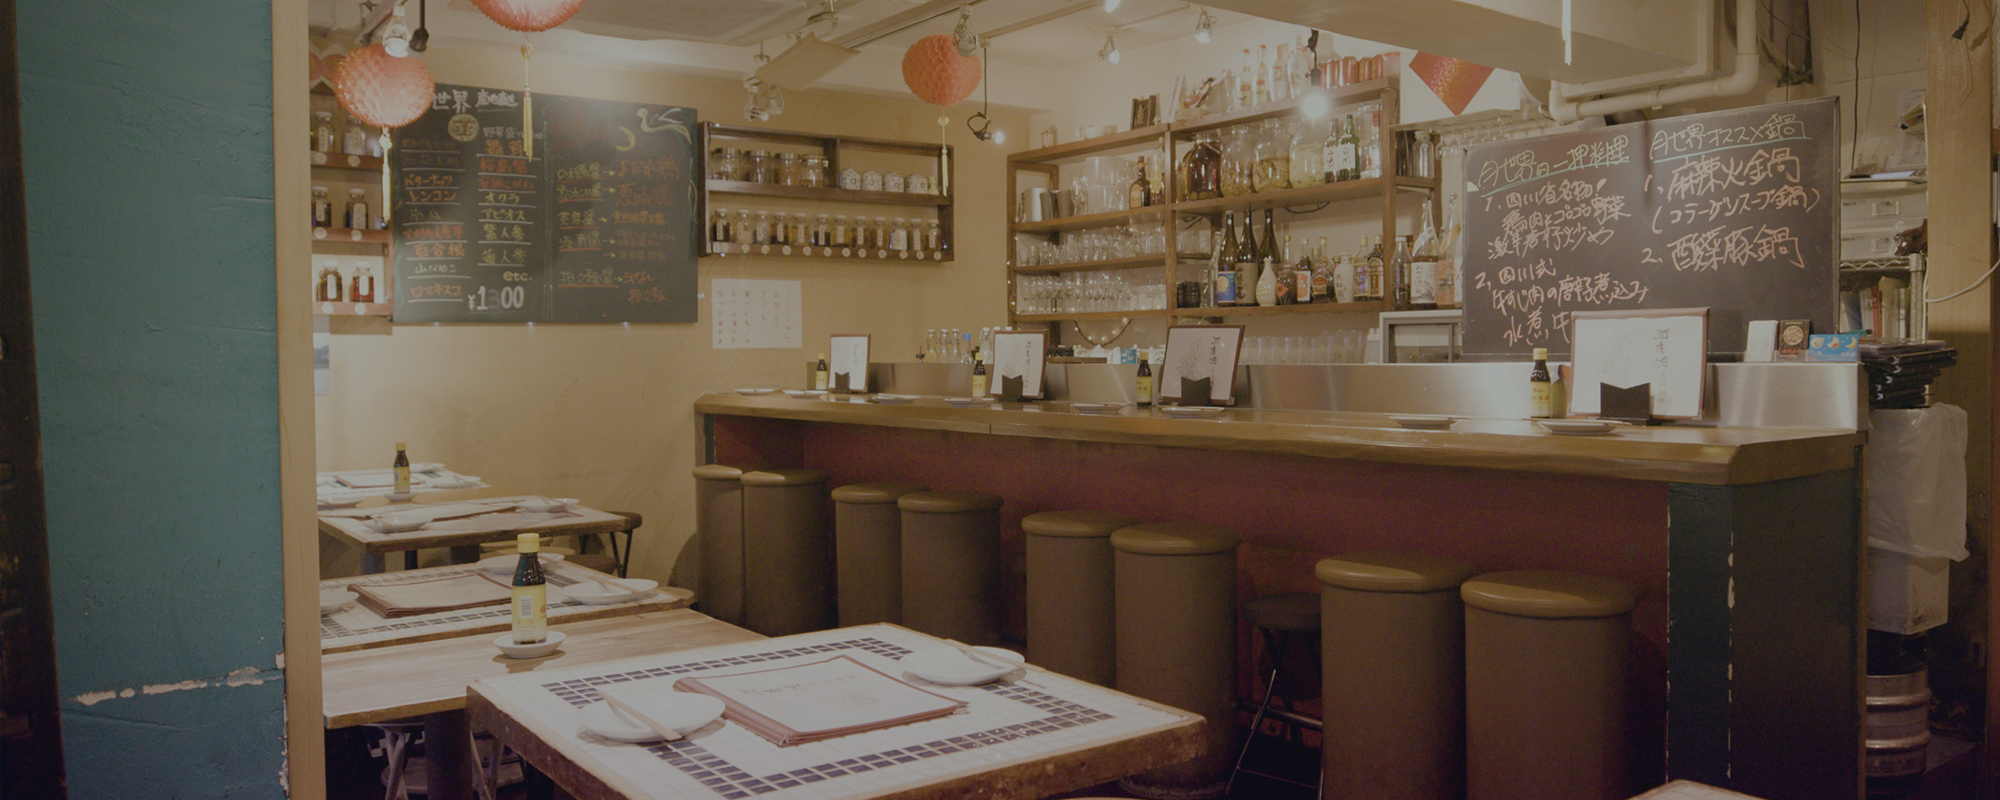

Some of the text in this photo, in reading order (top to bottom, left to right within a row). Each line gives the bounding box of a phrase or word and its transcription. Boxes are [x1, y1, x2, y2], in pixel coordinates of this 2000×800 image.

[1650, 113, 1806, 159] 月世界オススメ鍋
[404, 173, 453, 187] バターナッツ
[1667, 148, 1800, 202] 麻辣火鍋
[409, 190, 456, 202] レンコン
[485, 192, 521, 204] オクラ
[481, 208, 526, 221] アピオス
[413, 242, 466, 258] 百合根
[503, 270, 533, 282] etc.
[410, 282, 462, 298] ロマネスコ
[467, 285, 525, 311] ¥1300
